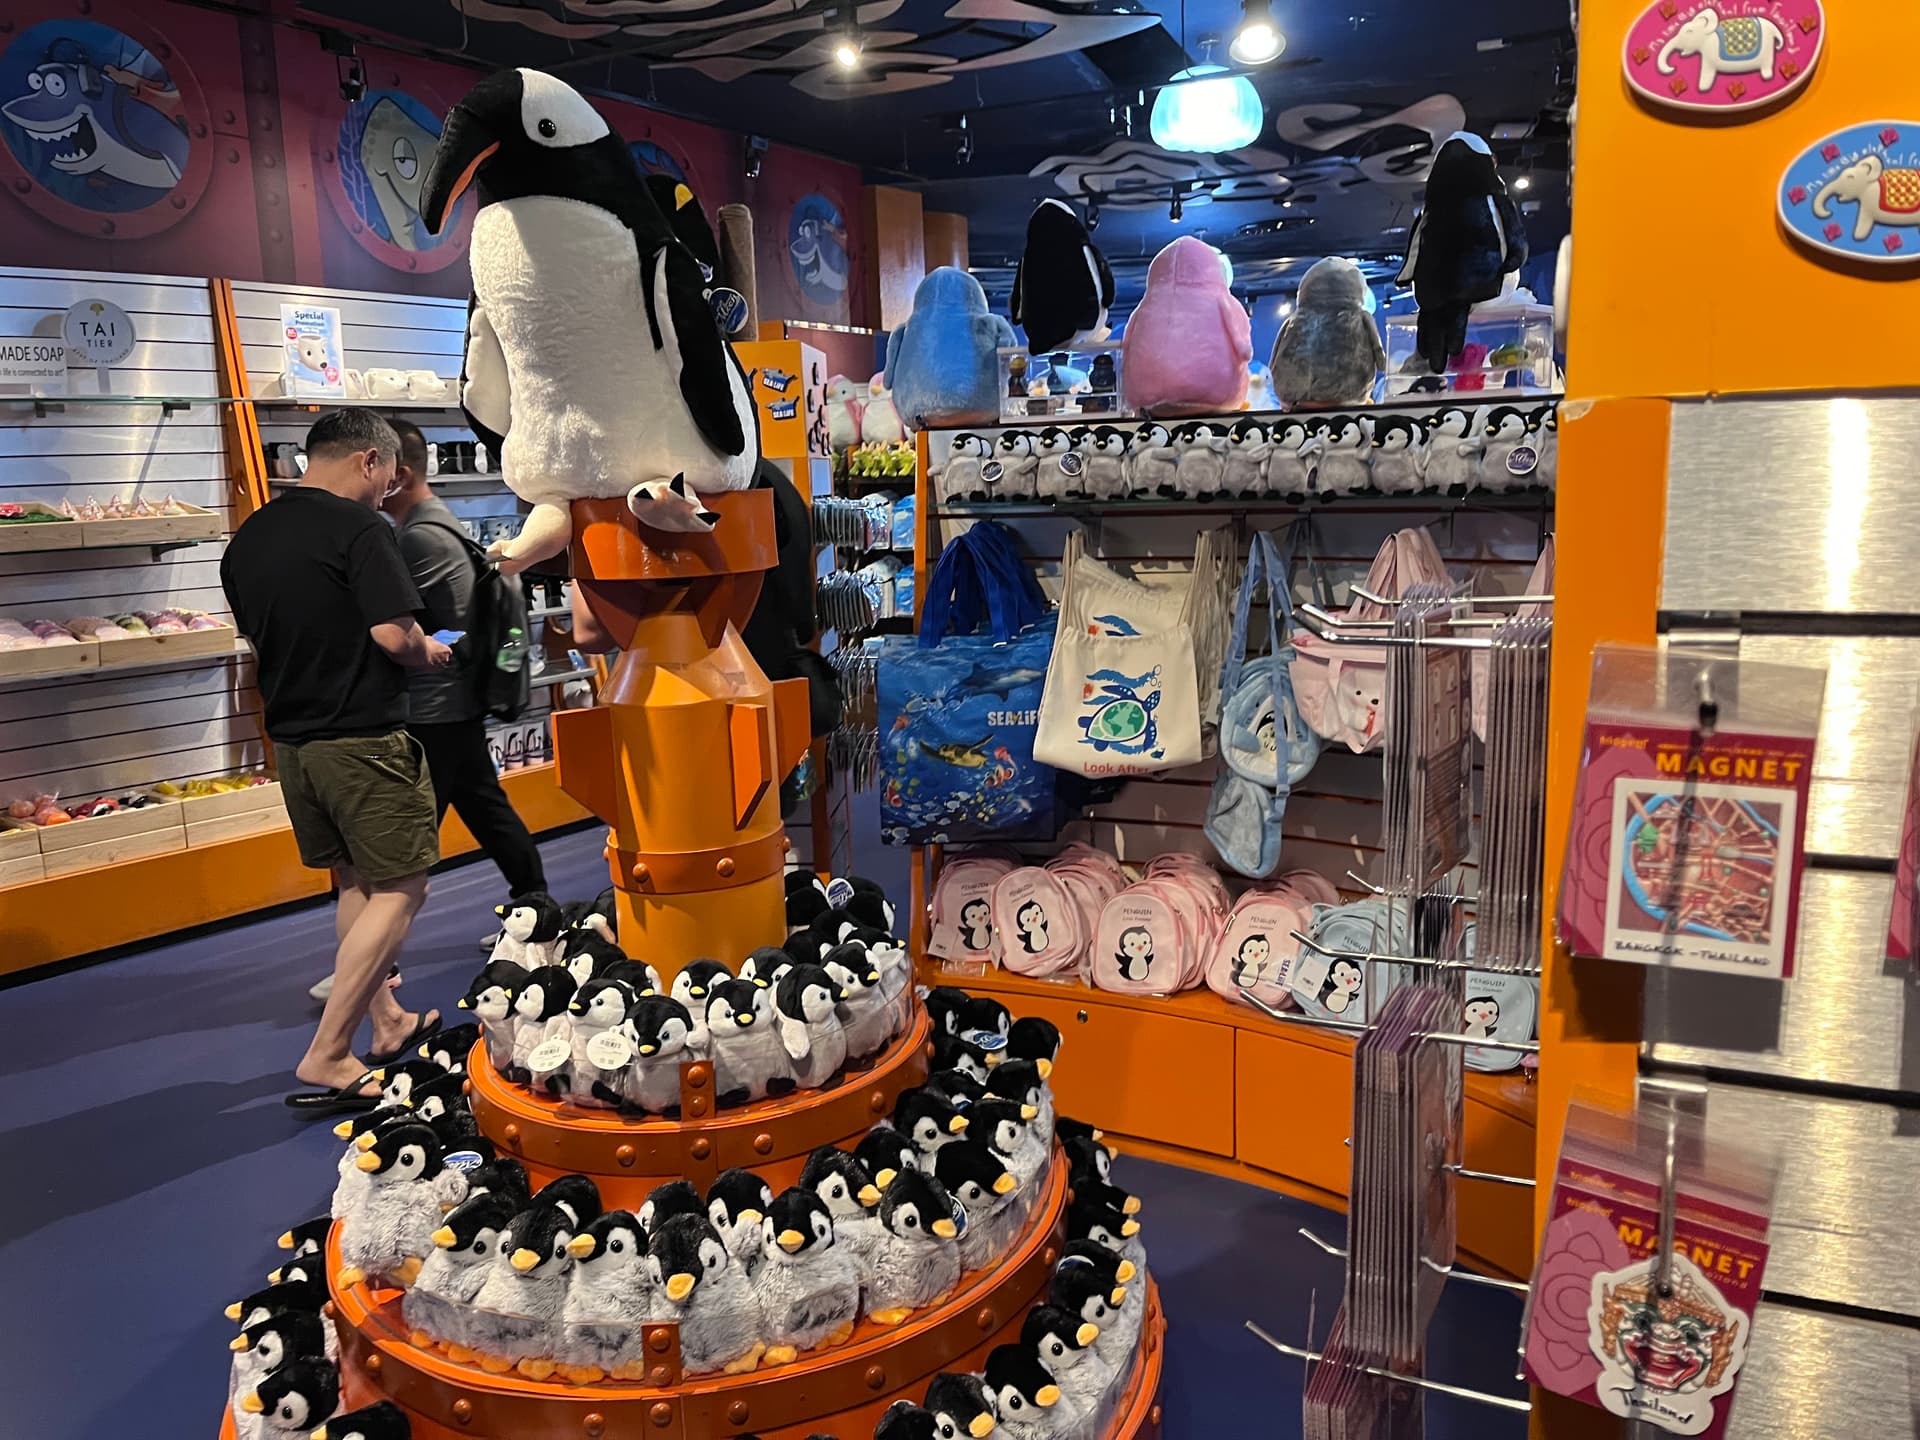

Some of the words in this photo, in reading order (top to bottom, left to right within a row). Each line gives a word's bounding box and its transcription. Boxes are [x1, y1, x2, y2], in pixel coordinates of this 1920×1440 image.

[295, 310, 325, 321] Special
[80, 321, 116, 337] TAI
[87, 339, 113, 348] TIER
[33, 346, 64, 361] SOAP
[987, 711, 1015, 727] SEA
[1083, 762, 1114, 774] Look
[1117, 764, 1150, 775] After
[1655, 751, 1802, 782] MAGNET
[1615, 941, 1683, 956] BANGKOK
